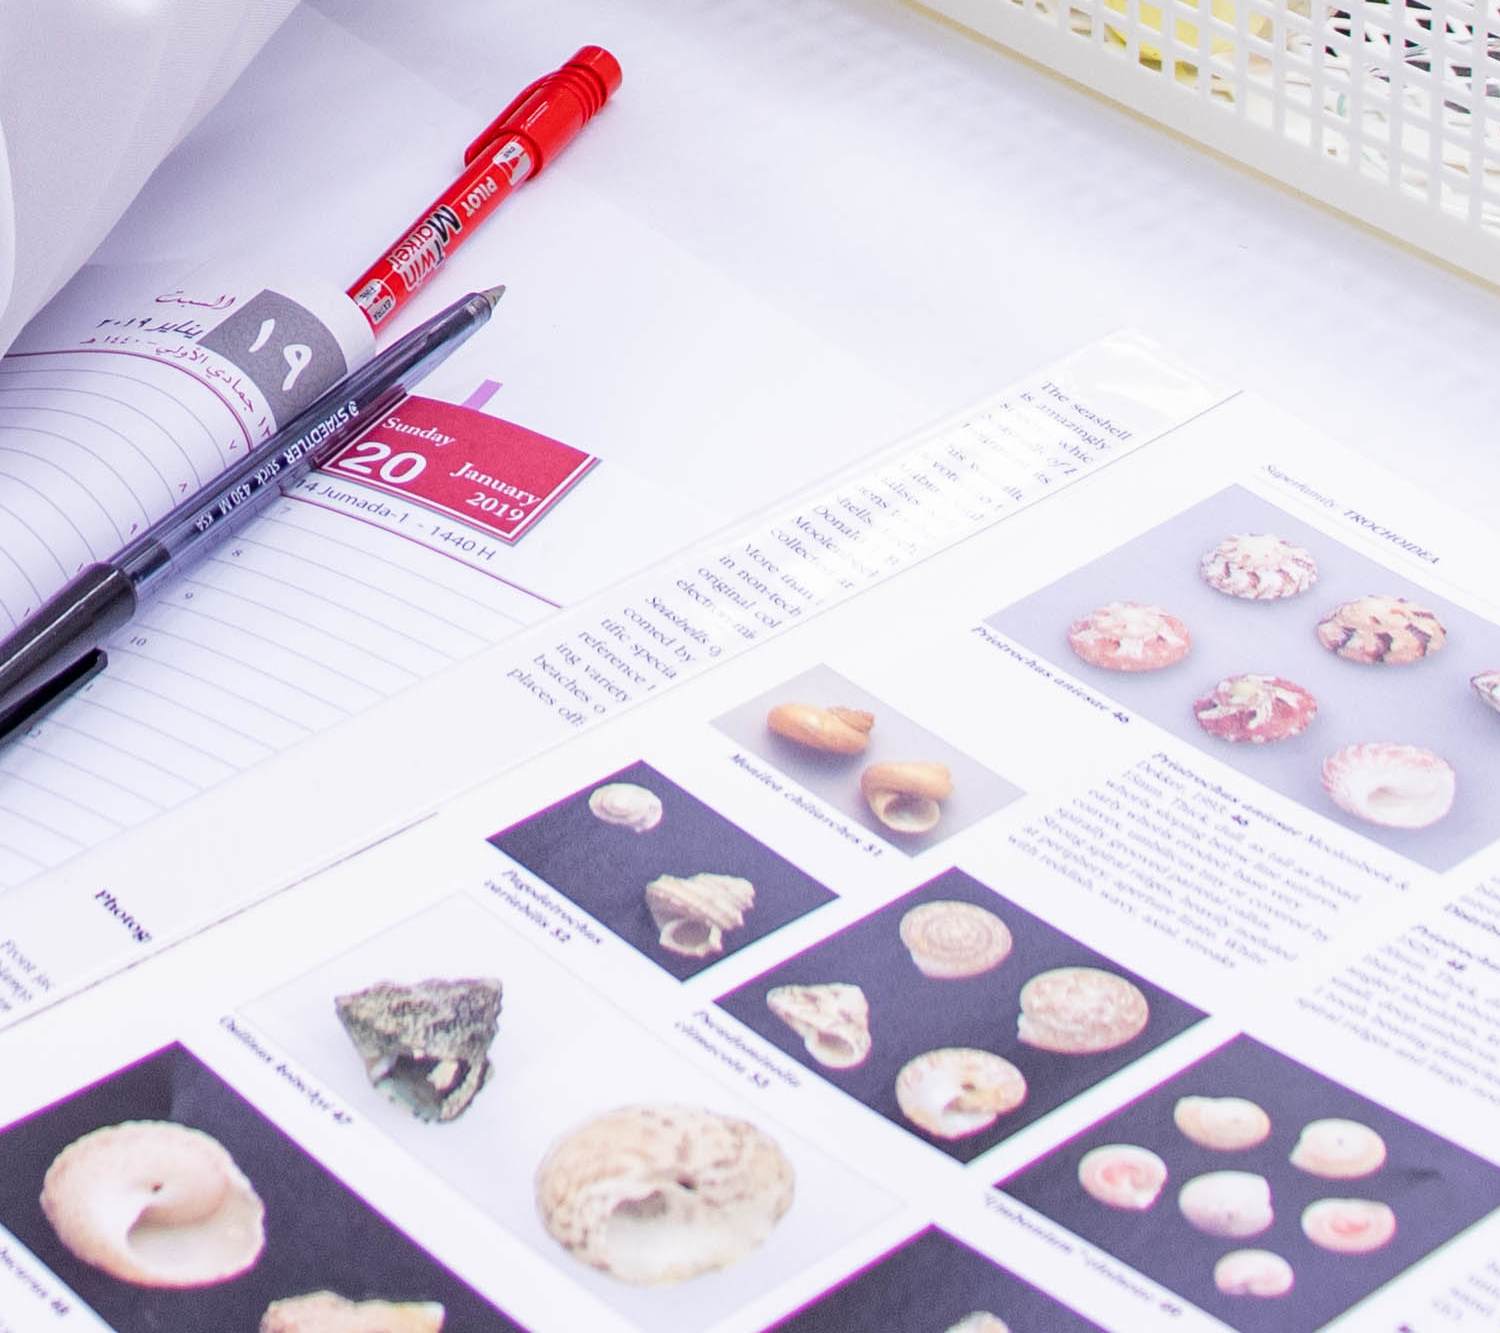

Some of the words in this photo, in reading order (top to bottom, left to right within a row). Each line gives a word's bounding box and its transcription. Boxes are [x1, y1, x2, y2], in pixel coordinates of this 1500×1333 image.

[460, 176, 499, 218] PILOT
[284, 406, 350, 466] STAEDTLER
[381, 416, 456, 448] Sunday
[1071, 404, 1132, 440] seashell
[338, 440, 428, 485] 20
[448, 461, 542, 507] January
[465, 491, 526, 523] 2019
[430, 525, 478, 553] 1440
[477, 545, 498, 561] H
